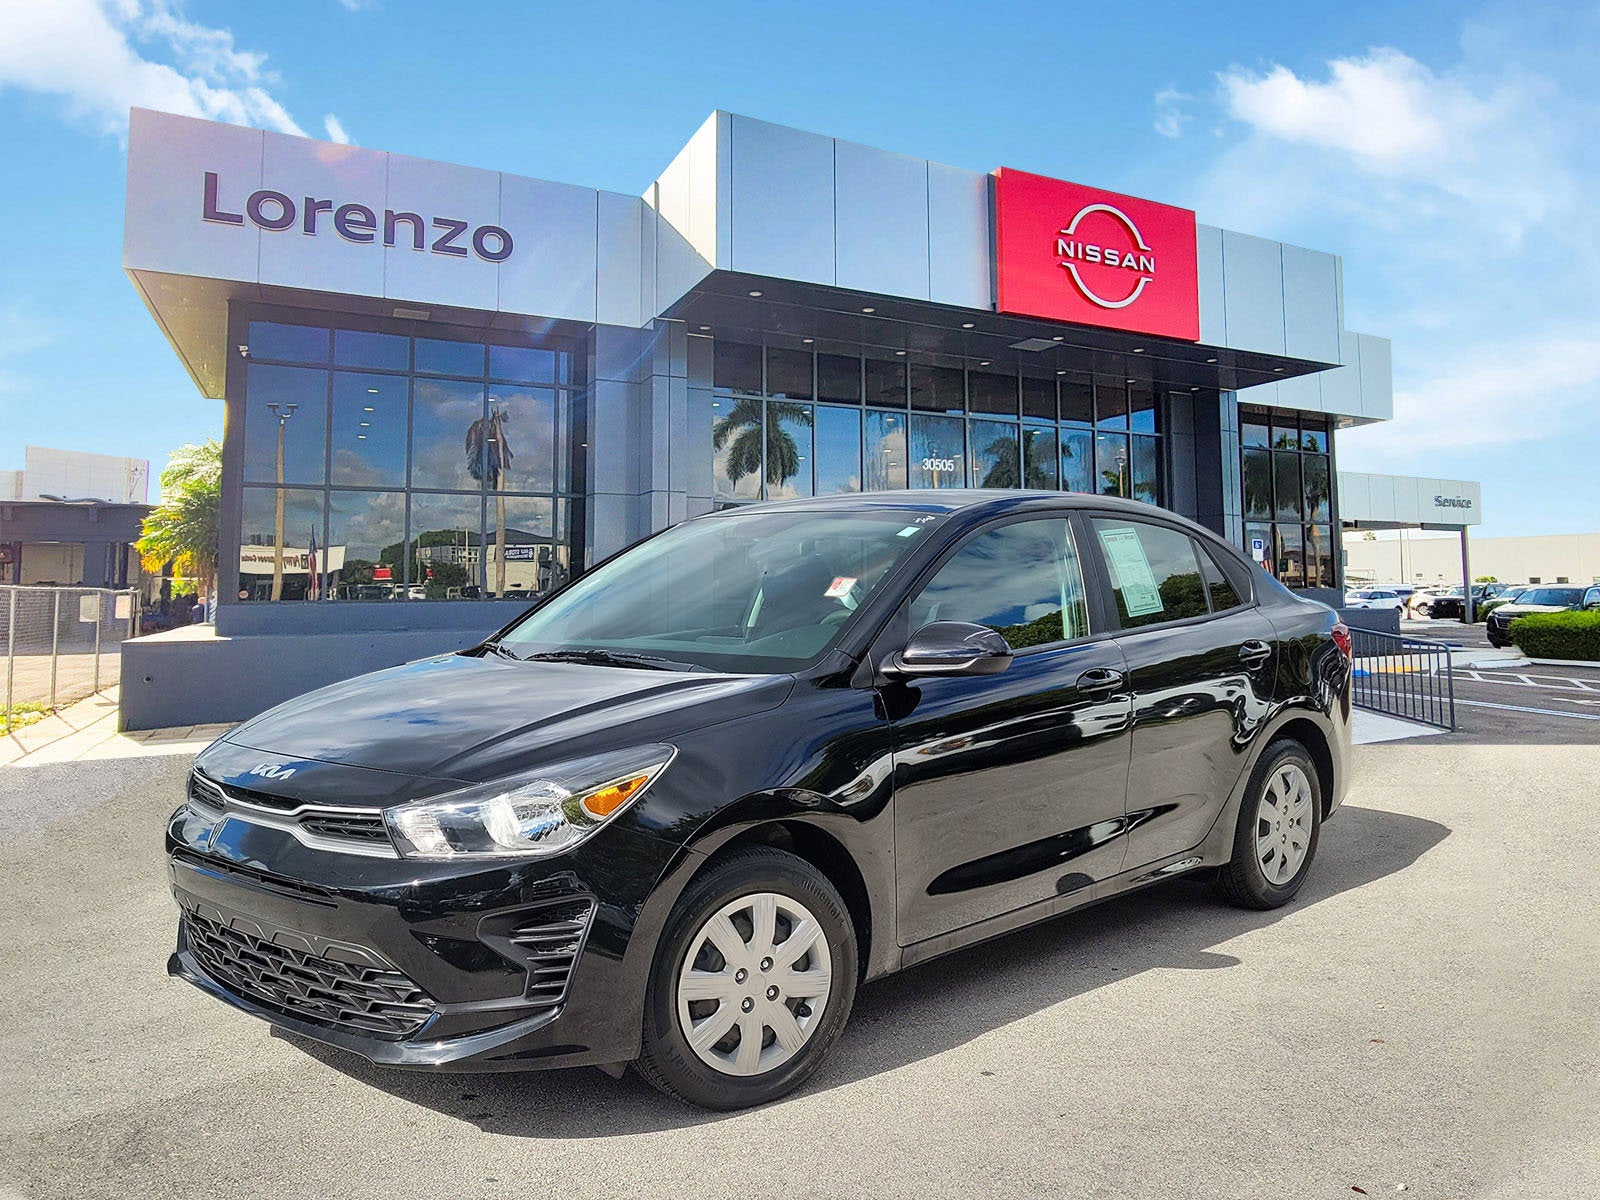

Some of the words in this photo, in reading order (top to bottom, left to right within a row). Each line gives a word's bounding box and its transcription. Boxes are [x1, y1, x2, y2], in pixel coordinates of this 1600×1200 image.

[202, 171, 514, 262] Lorenzo
[1057, 238, 1155, 273] NISSAN
[922, 458, 955, 472] 30505
[1434, 495, 1472, 508] Service
[250, 763, 297, 780] KIA
